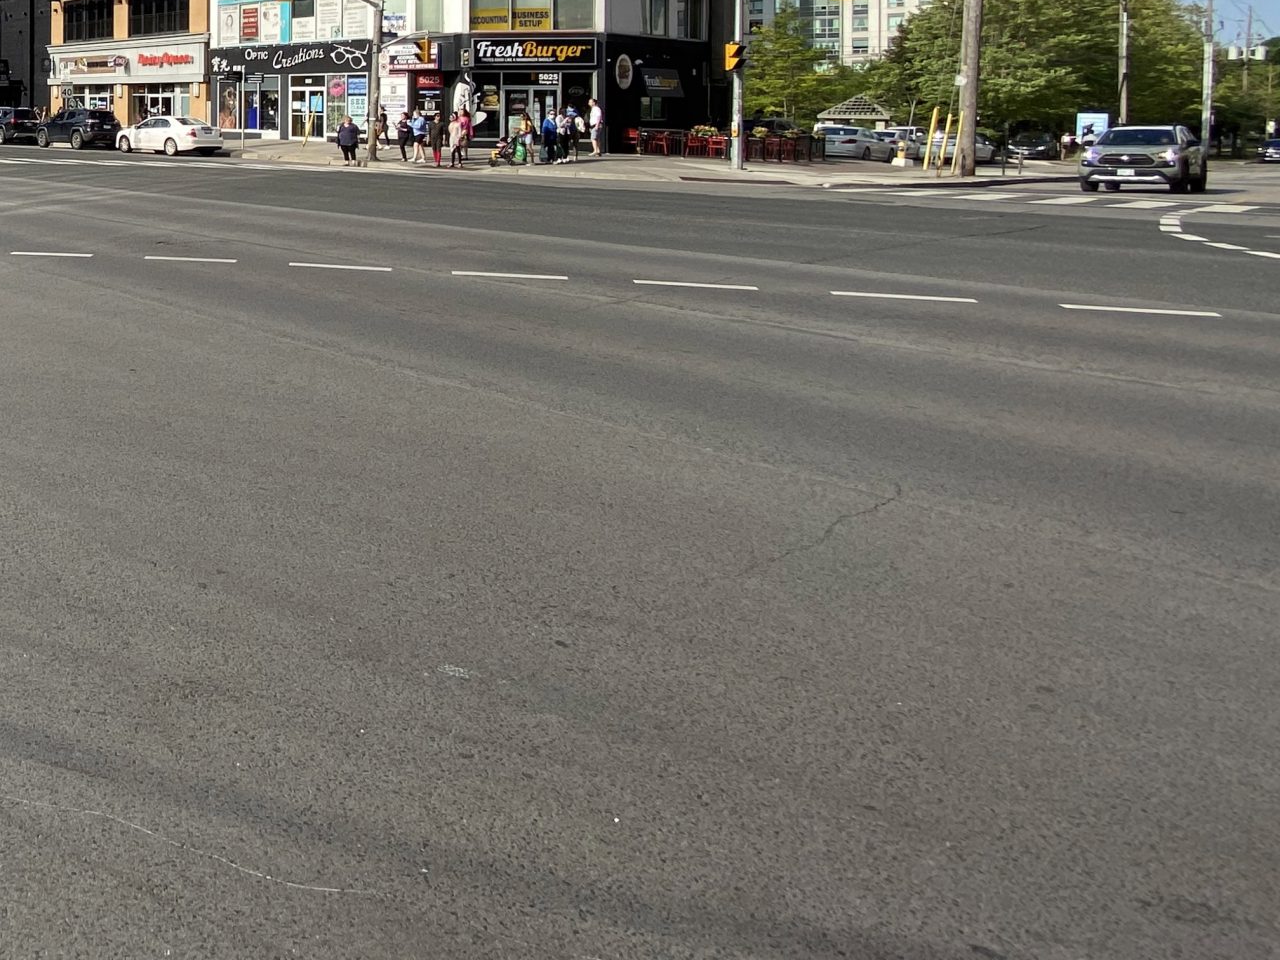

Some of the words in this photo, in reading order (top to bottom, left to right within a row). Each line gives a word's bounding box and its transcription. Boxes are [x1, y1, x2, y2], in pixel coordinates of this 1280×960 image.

[511, 11, 549, 19] BUSINESS
[470, 15, 508, 25] ACCOUNTING
[518, 19, 543, 27] SETUP
[476, 41, 586, 62] FreshBurger
[272, 47, 325, 69] Creations
[419, 76, 440, 84] 5025
[62, 88, 72, 97] 40
